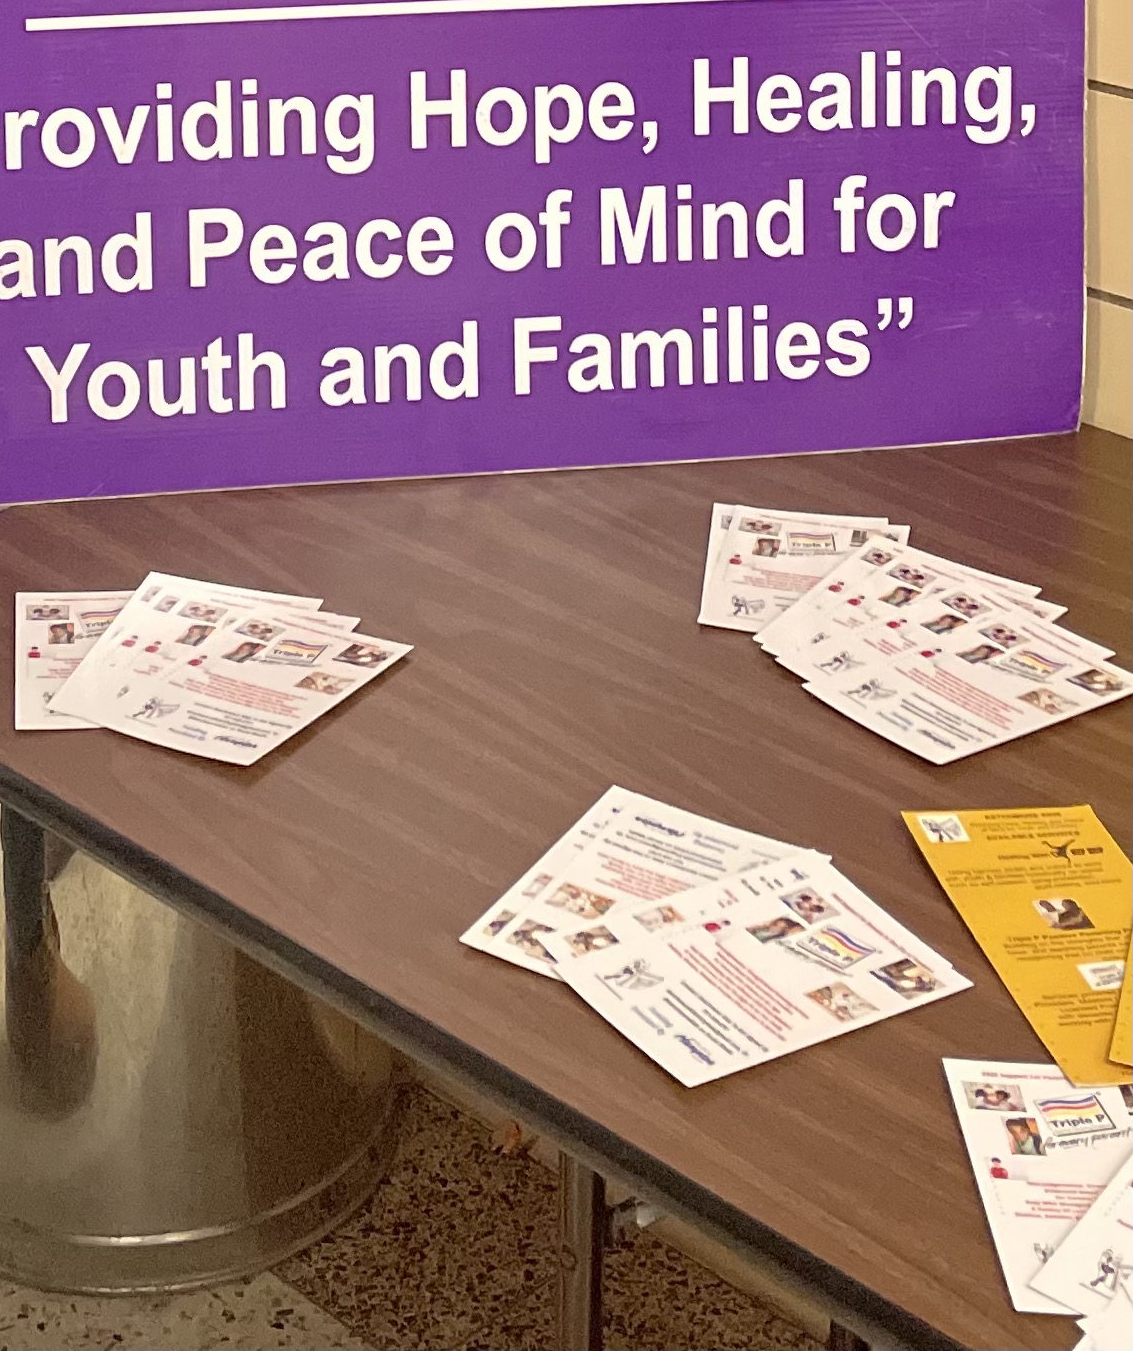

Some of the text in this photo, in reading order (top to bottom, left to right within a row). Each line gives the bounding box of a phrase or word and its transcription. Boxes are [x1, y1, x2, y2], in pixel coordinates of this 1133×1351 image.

[411, 69, 658, 164] Hope,
[693, 50, 1036, 145] Healing,
[189, 208, 455, 288] Peace
[485, 189, 573, 271] of
[600, 179, 805, 265] Mind
[834, 175, 956, 253] for
[25, 297, 914, 423] Youth and Families”
[1050, 1114, 1105, 1130] Triple P
